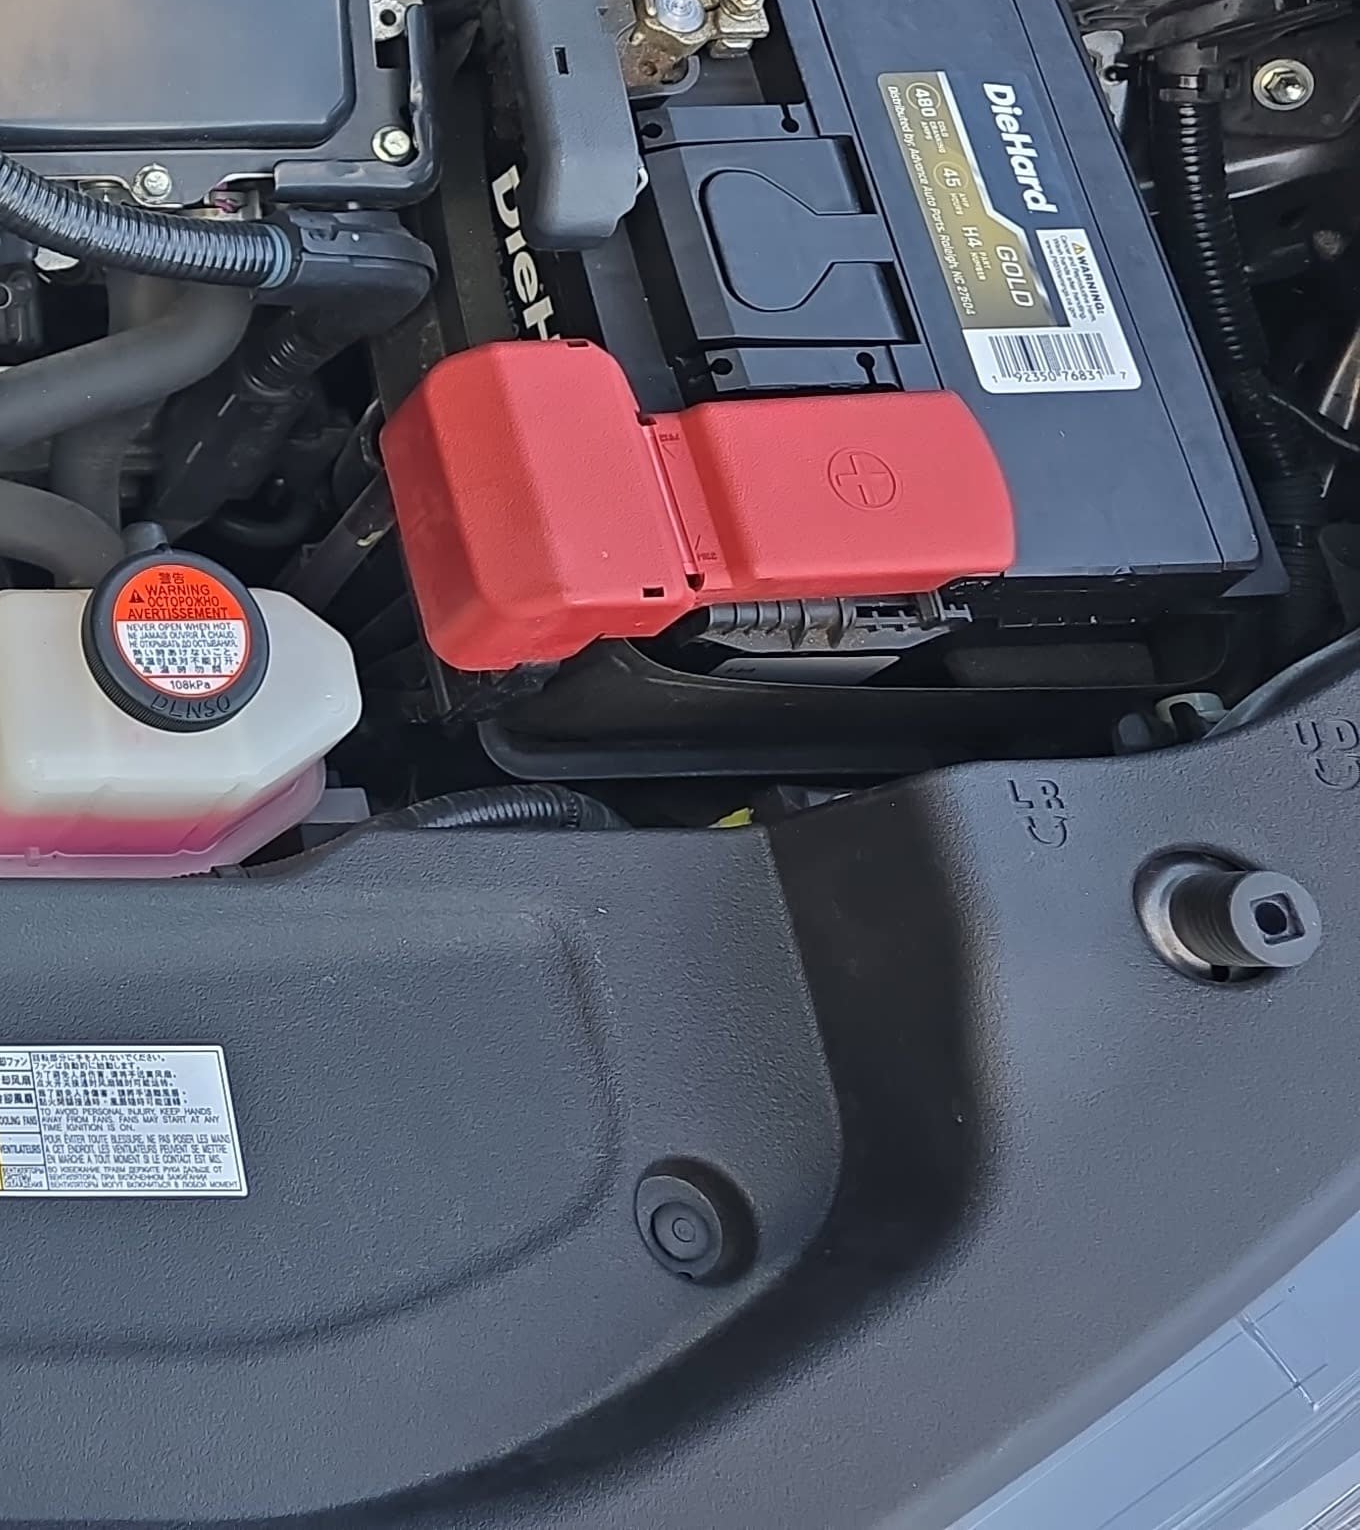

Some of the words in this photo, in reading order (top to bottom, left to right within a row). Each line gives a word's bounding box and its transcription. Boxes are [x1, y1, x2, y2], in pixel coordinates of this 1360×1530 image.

[887, 86, 913, 132] Distributed
[913, 88, 938, 116] 480
[982, 82, 1057, 211] DieHard
[907, 147, 930, 184] Advance
[940, 167, 961, 186] 45
[921, 185, 937, 206] Auto
[961, 226, 984, 248] H4
[951, 270, 965, 284] NC
[994, 245, 1035, 306] GOLD
[1076, 255, 1106, 314] WARNING:
[956, 285, 976, 315] 27604
[1015, 370, 1057, 383] 92350
[1062, 370, 1103, 382] 76831
[1119, 371, 1127, 380] 7
[145, 584, 210, 595] WARNING
[128, 607, 227, 619] AVERTISSEMENT
[170, 680, 211, 689] 108kPa
[151, 694, 231, 719] DENSO
